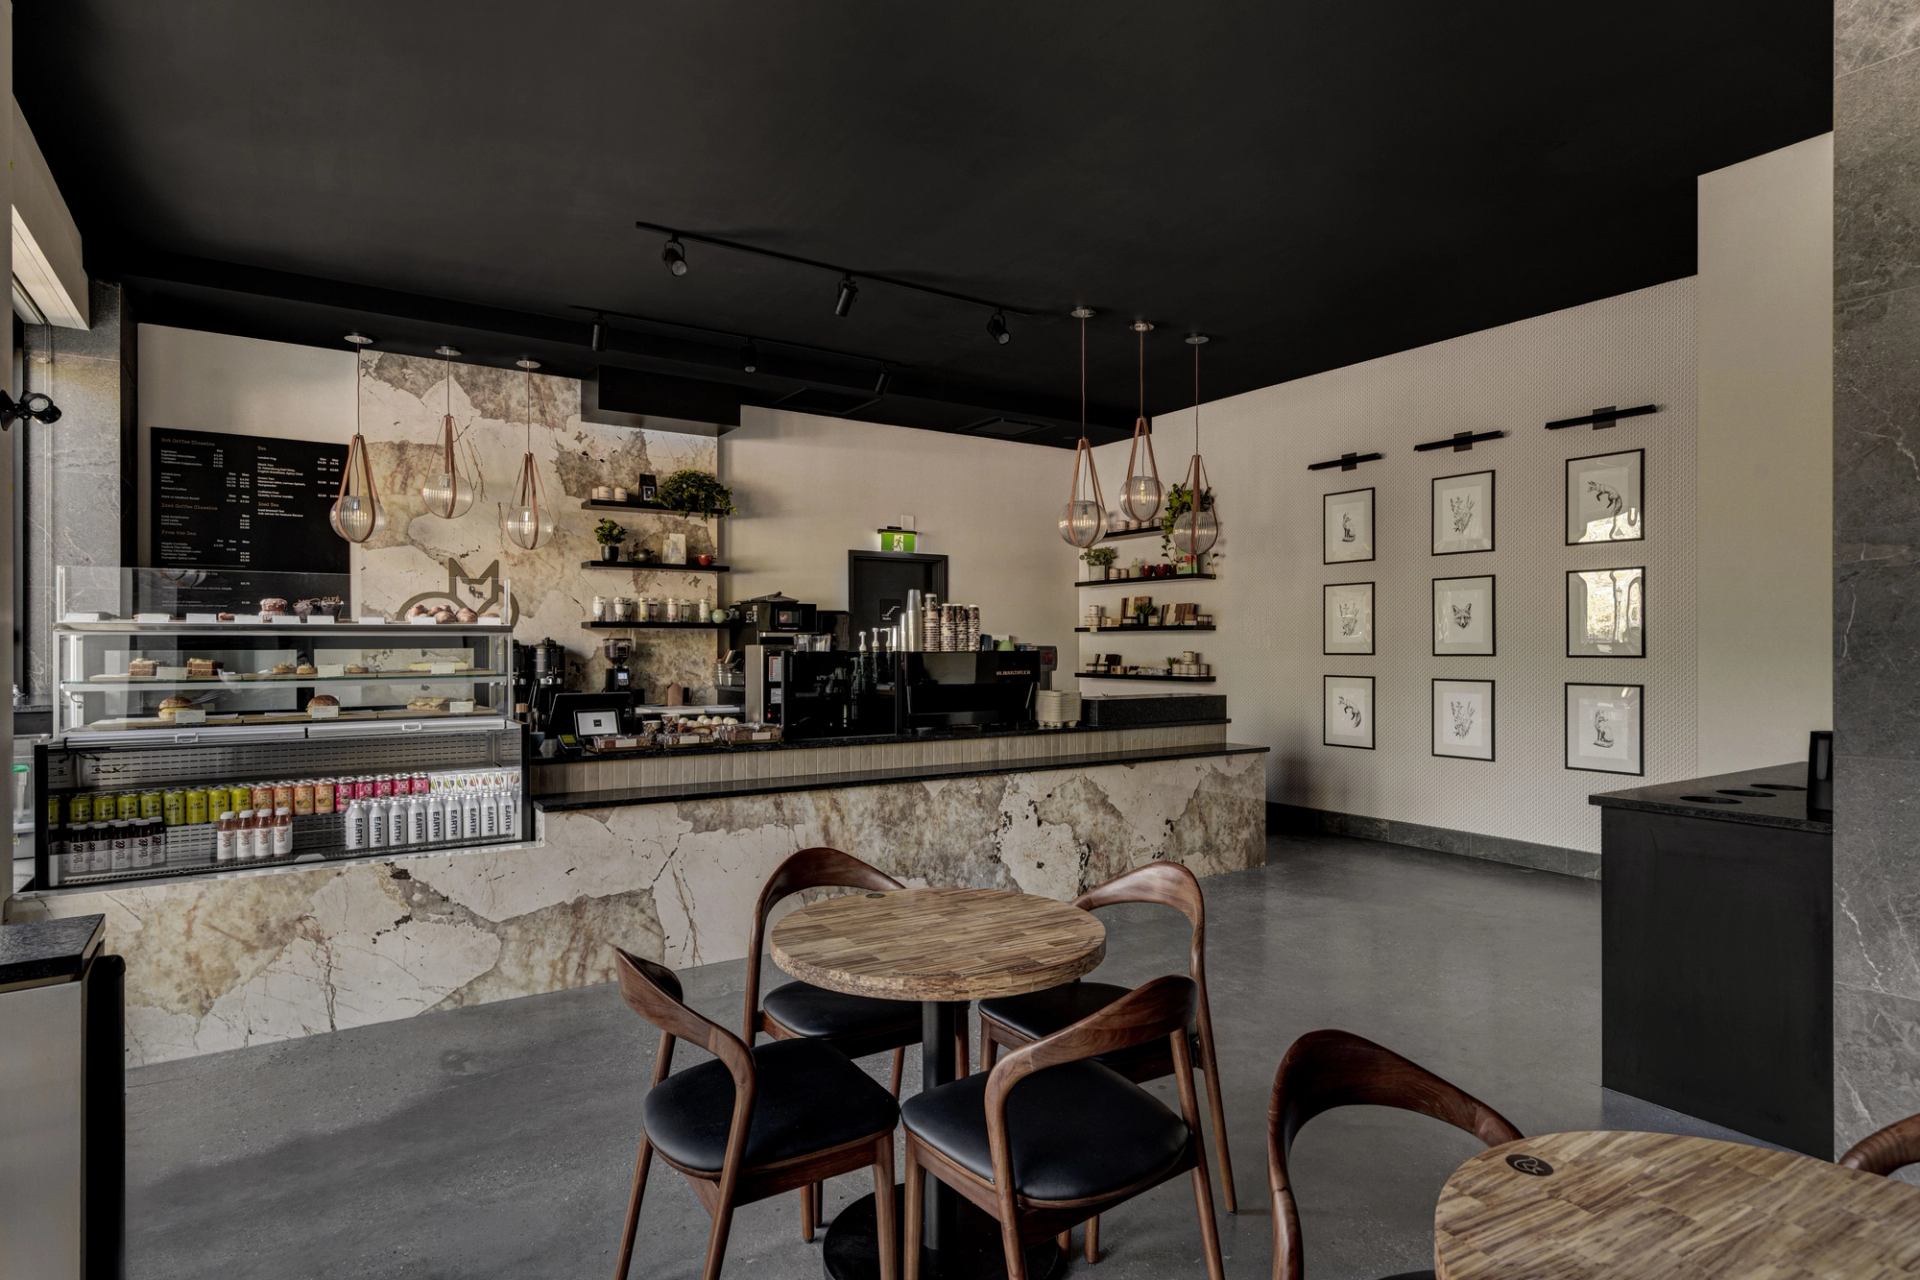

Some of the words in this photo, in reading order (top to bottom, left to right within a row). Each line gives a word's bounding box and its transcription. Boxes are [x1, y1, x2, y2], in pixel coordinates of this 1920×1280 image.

[355, 817, 363, 845] EARTH
[374, 816, 382, 843] EARTH
[394, 814, 402, 841] EARTH
[432, 811, 440, 838] EARTH
[450, 809, 458, 836] EARTH
